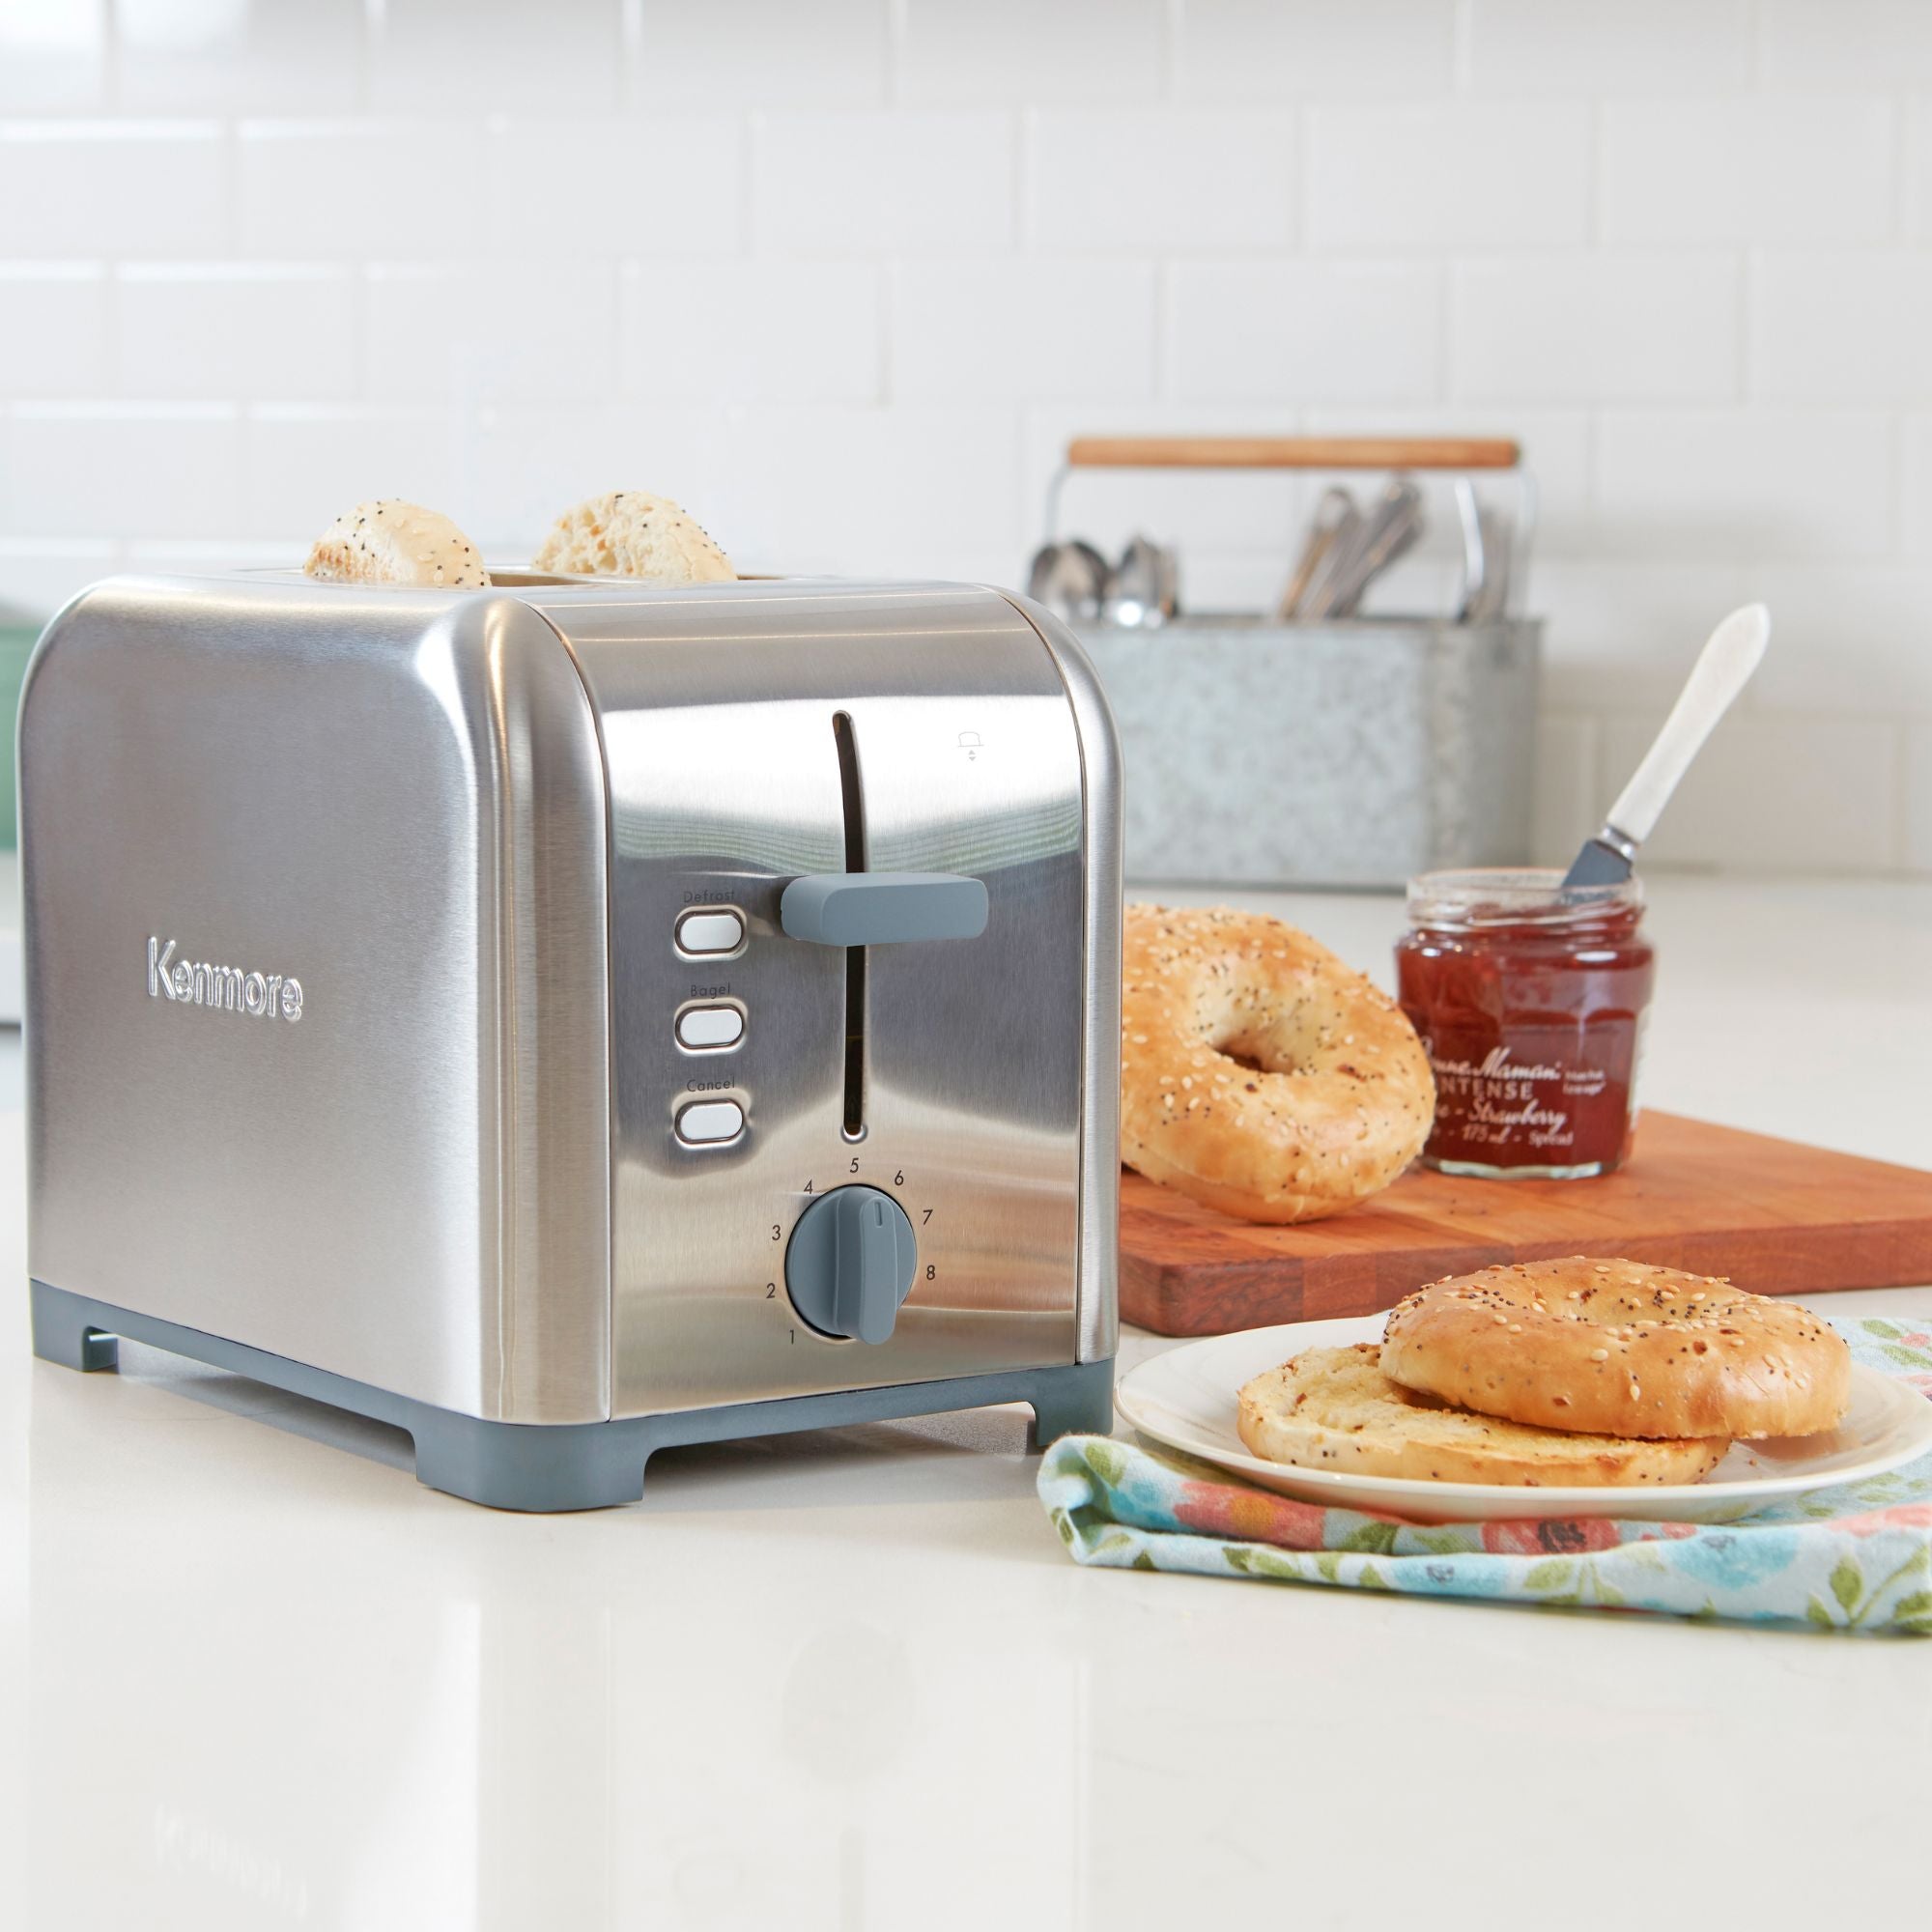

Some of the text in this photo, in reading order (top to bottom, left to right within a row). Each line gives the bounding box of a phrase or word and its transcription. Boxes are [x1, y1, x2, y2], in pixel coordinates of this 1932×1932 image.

[683, 890, 735, 904] Defrost
[148, 936, 303, 1022] Kenmore
[690, 981, 731, 1000] Bagel
[686, 1075, 736, 1093] Cancel
[1439, 1077, 1534, 1101] NTENSE
[1467, 1097, 1568, 1136] Strawberry
[1462, 1123, 1489, 1143] 175
[849, 1157, 860, 1174] 5
[894, 1169, 905, 1186] 6
[803, 1179, 814, 1195] 4
[923, 1208, 934, 1226] 7
[771, 1224, 782, 1241] 3
[925, 1264, 936, 1281] 8
[765, 1282, 777, 1299] 2
[788, 1329, 796, 1346] 1
